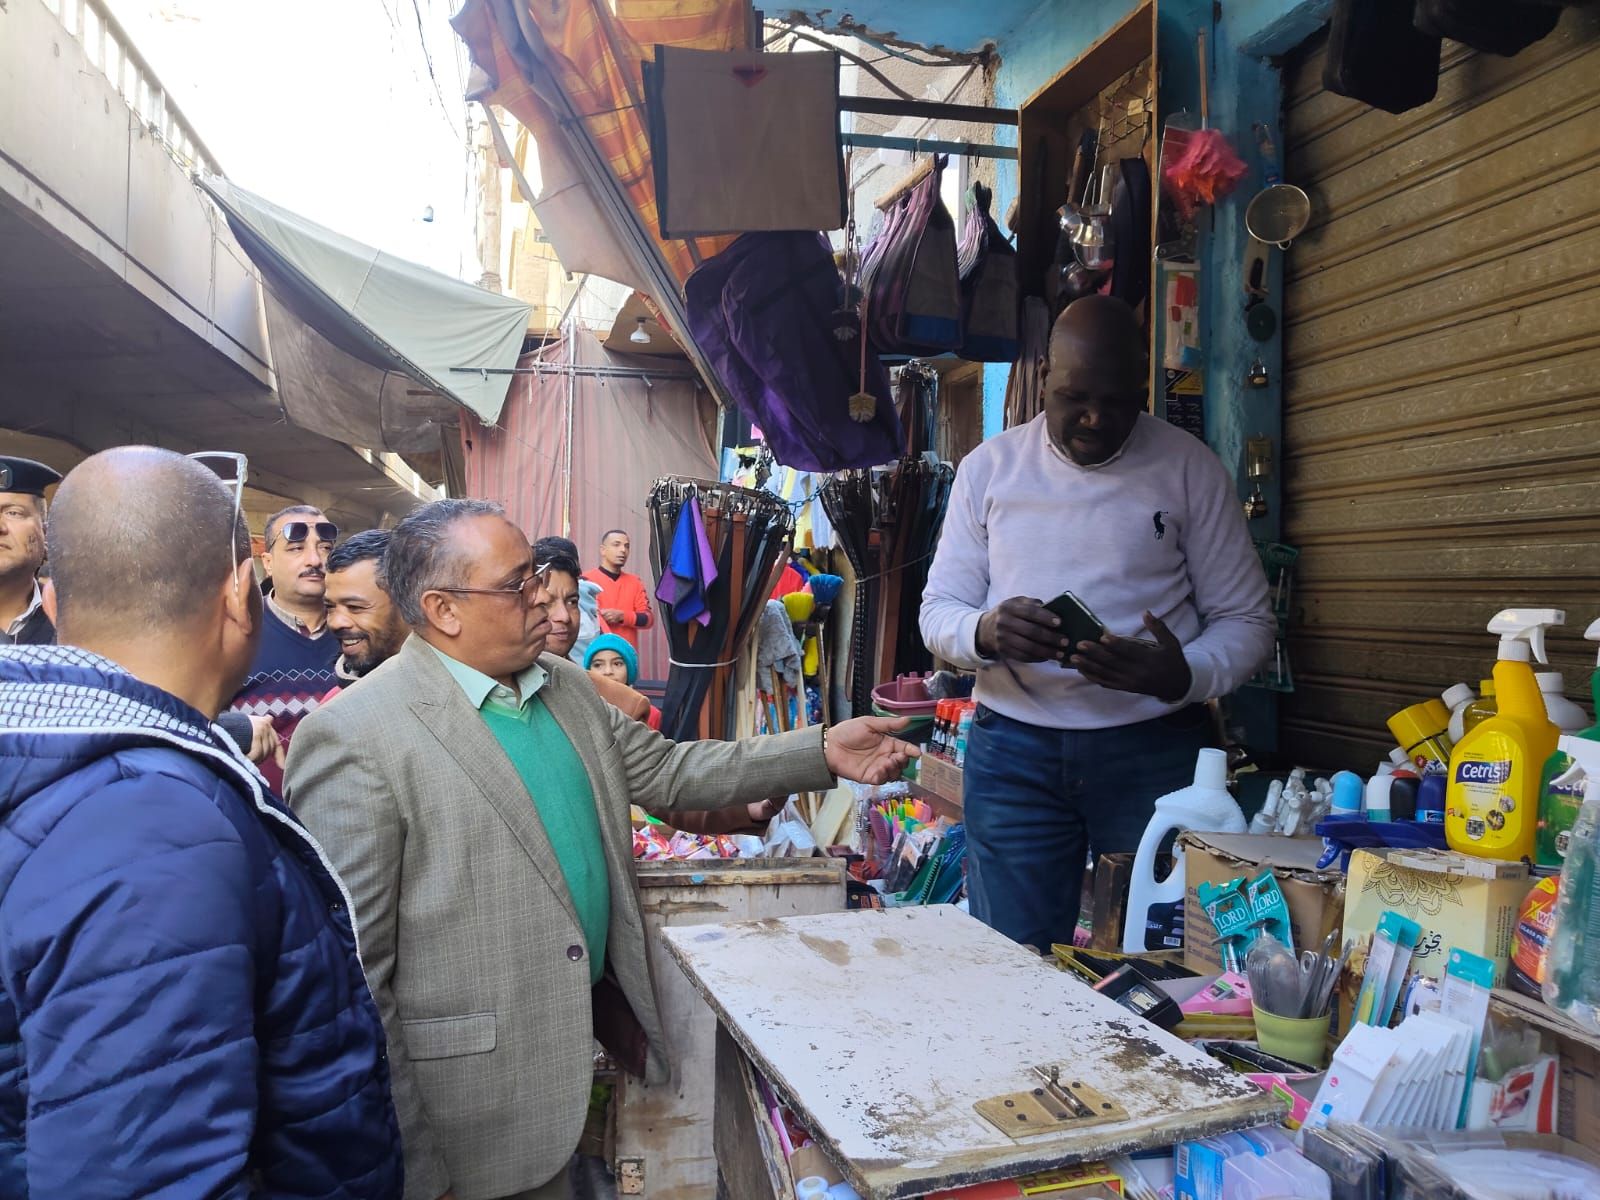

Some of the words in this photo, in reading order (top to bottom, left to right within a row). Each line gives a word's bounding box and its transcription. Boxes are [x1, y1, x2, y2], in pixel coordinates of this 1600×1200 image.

[1462, 763, 1501, 778] Cetris
[1254, 889, 1280, 913] LORD
[1216, 907, 1246, 929] LORD
[1413, 931, 1442, 958] بخور
